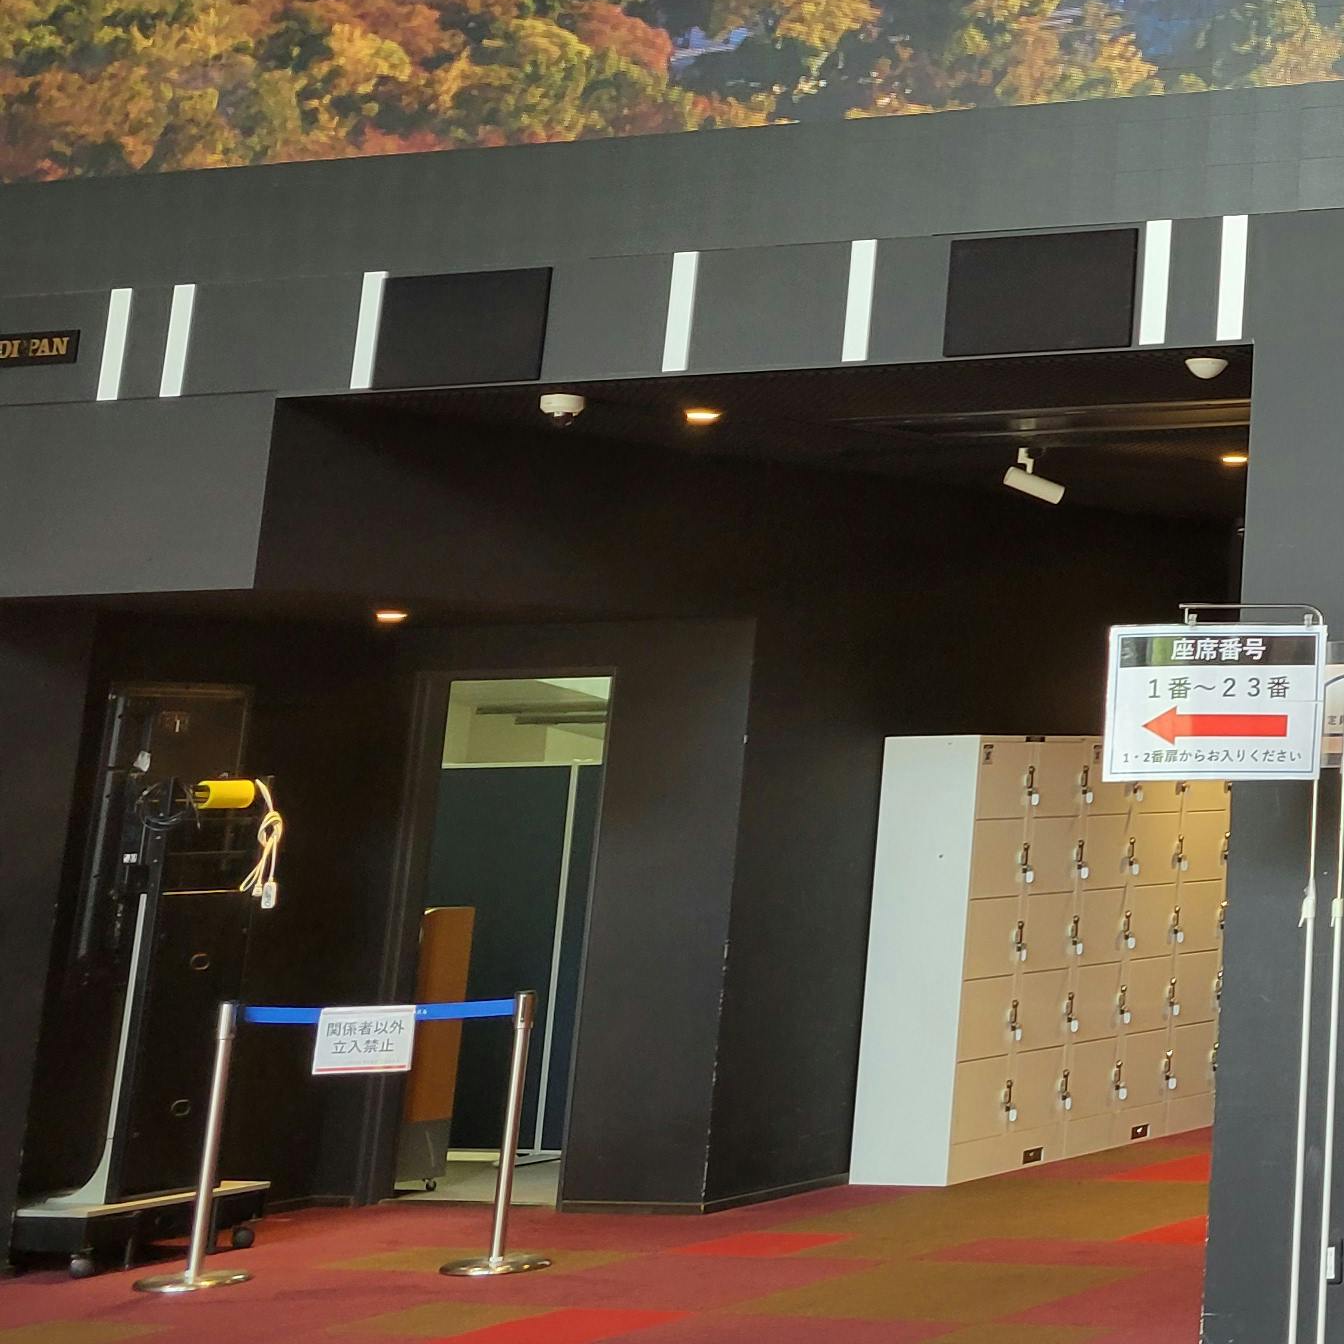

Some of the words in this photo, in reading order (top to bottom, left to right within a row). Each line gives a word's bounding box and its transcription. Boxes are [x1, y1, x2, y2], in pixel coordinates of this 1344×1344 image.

[29, 337, 69, 357] PAN
[1170, 637, 1266, 661] 座席番号
[326, 1020, 404, 1037] 関係者以外
[331, 1039, 394, 1055] 立入禁止
